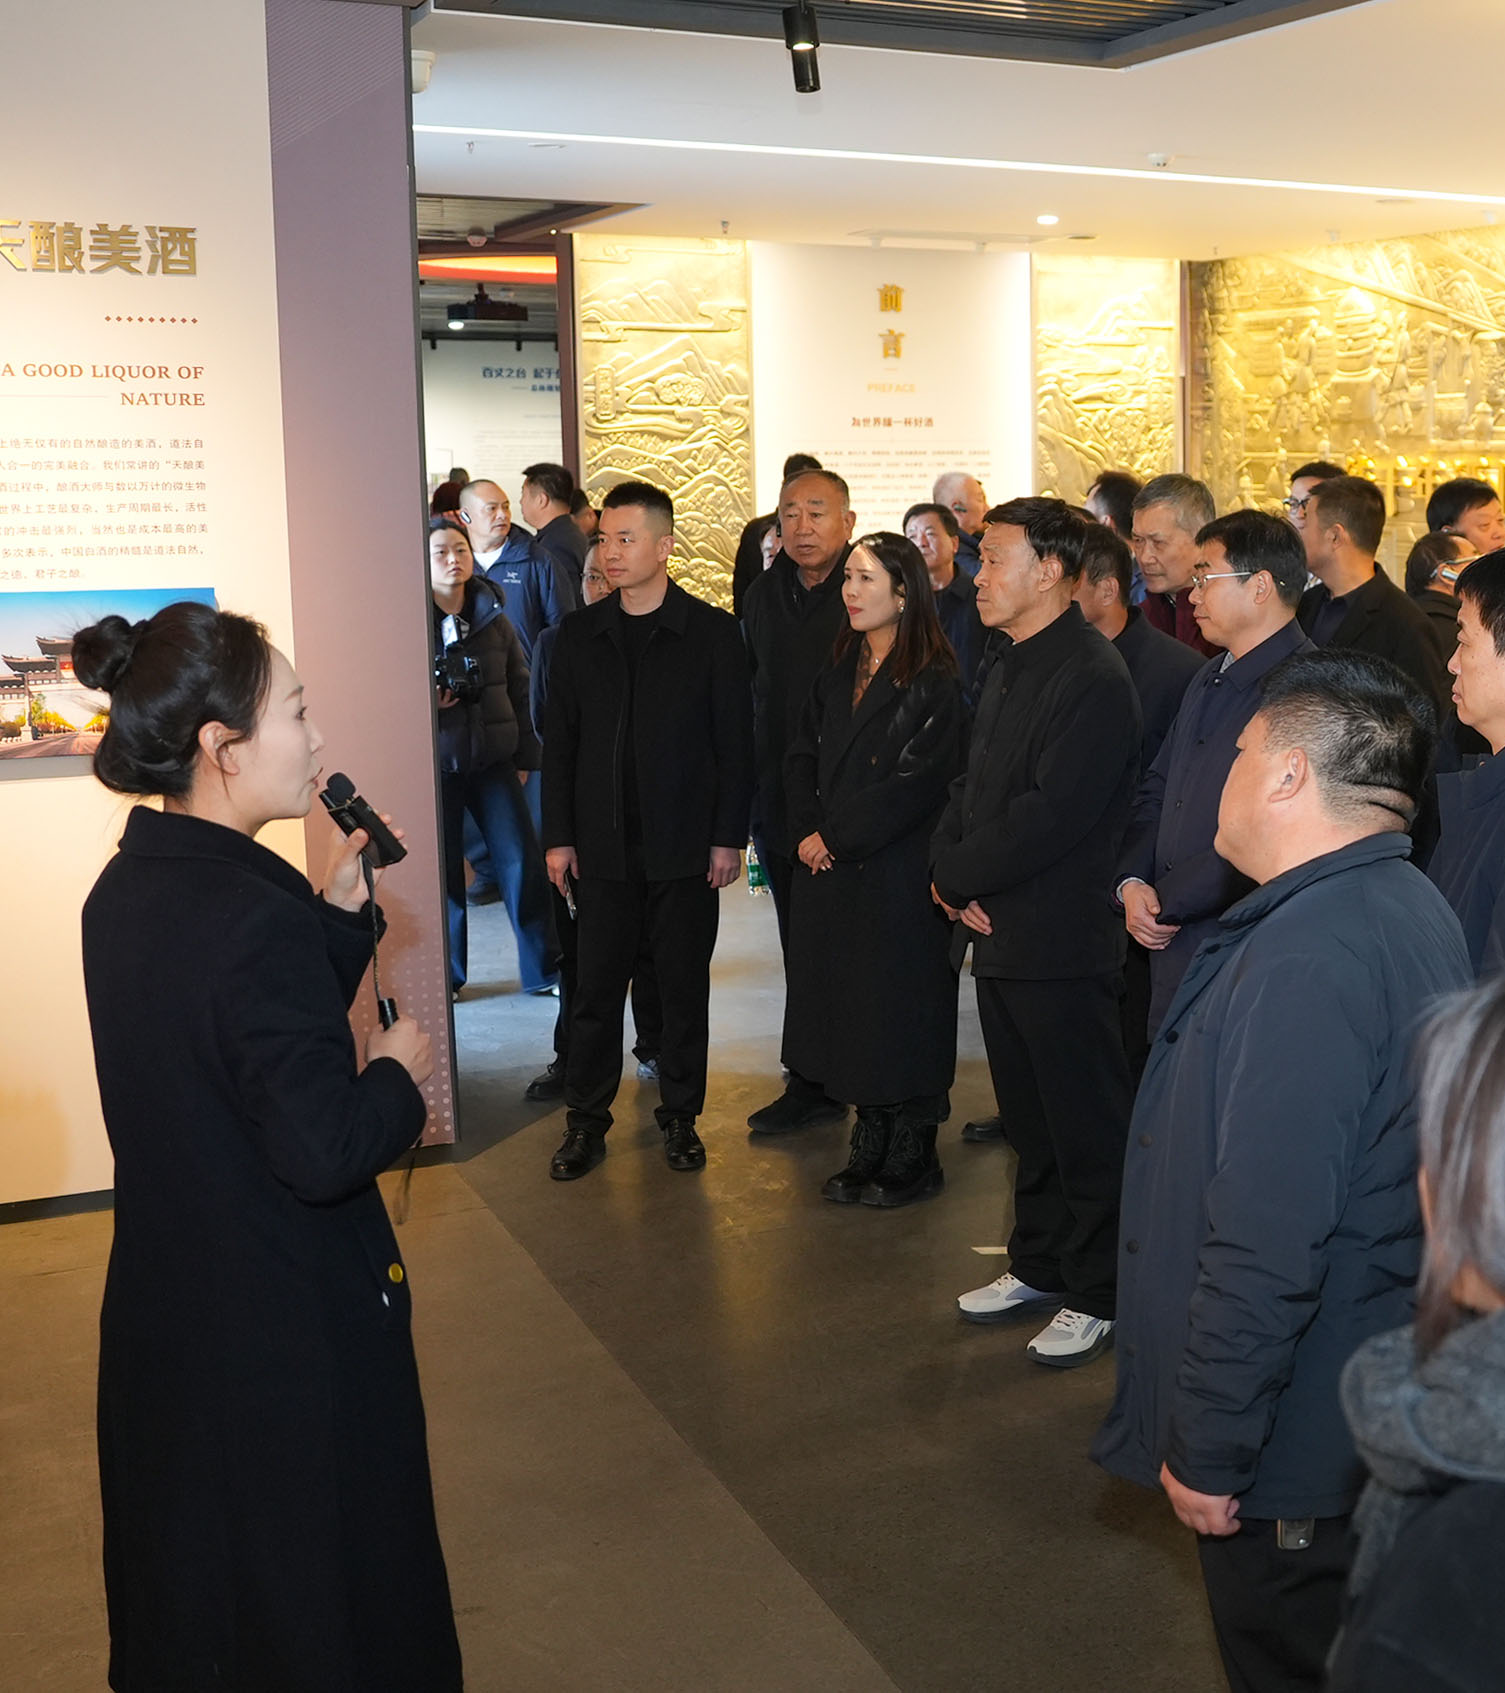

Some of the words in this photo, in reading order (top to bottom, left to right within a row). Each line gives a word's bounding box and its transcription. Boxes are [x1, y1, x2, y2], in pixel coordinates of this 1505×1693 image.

[877, 284, 905, 359] 前言
[1, 363, 16, 377] A
[23, 363, 83, 378] GOOD
[91, 365, 171, 382] LIQUOR
[177, 366, 204, 379] OF
[867, 383, 916, 393] PREFACE
[120, 392, 205, 406] NATURE
